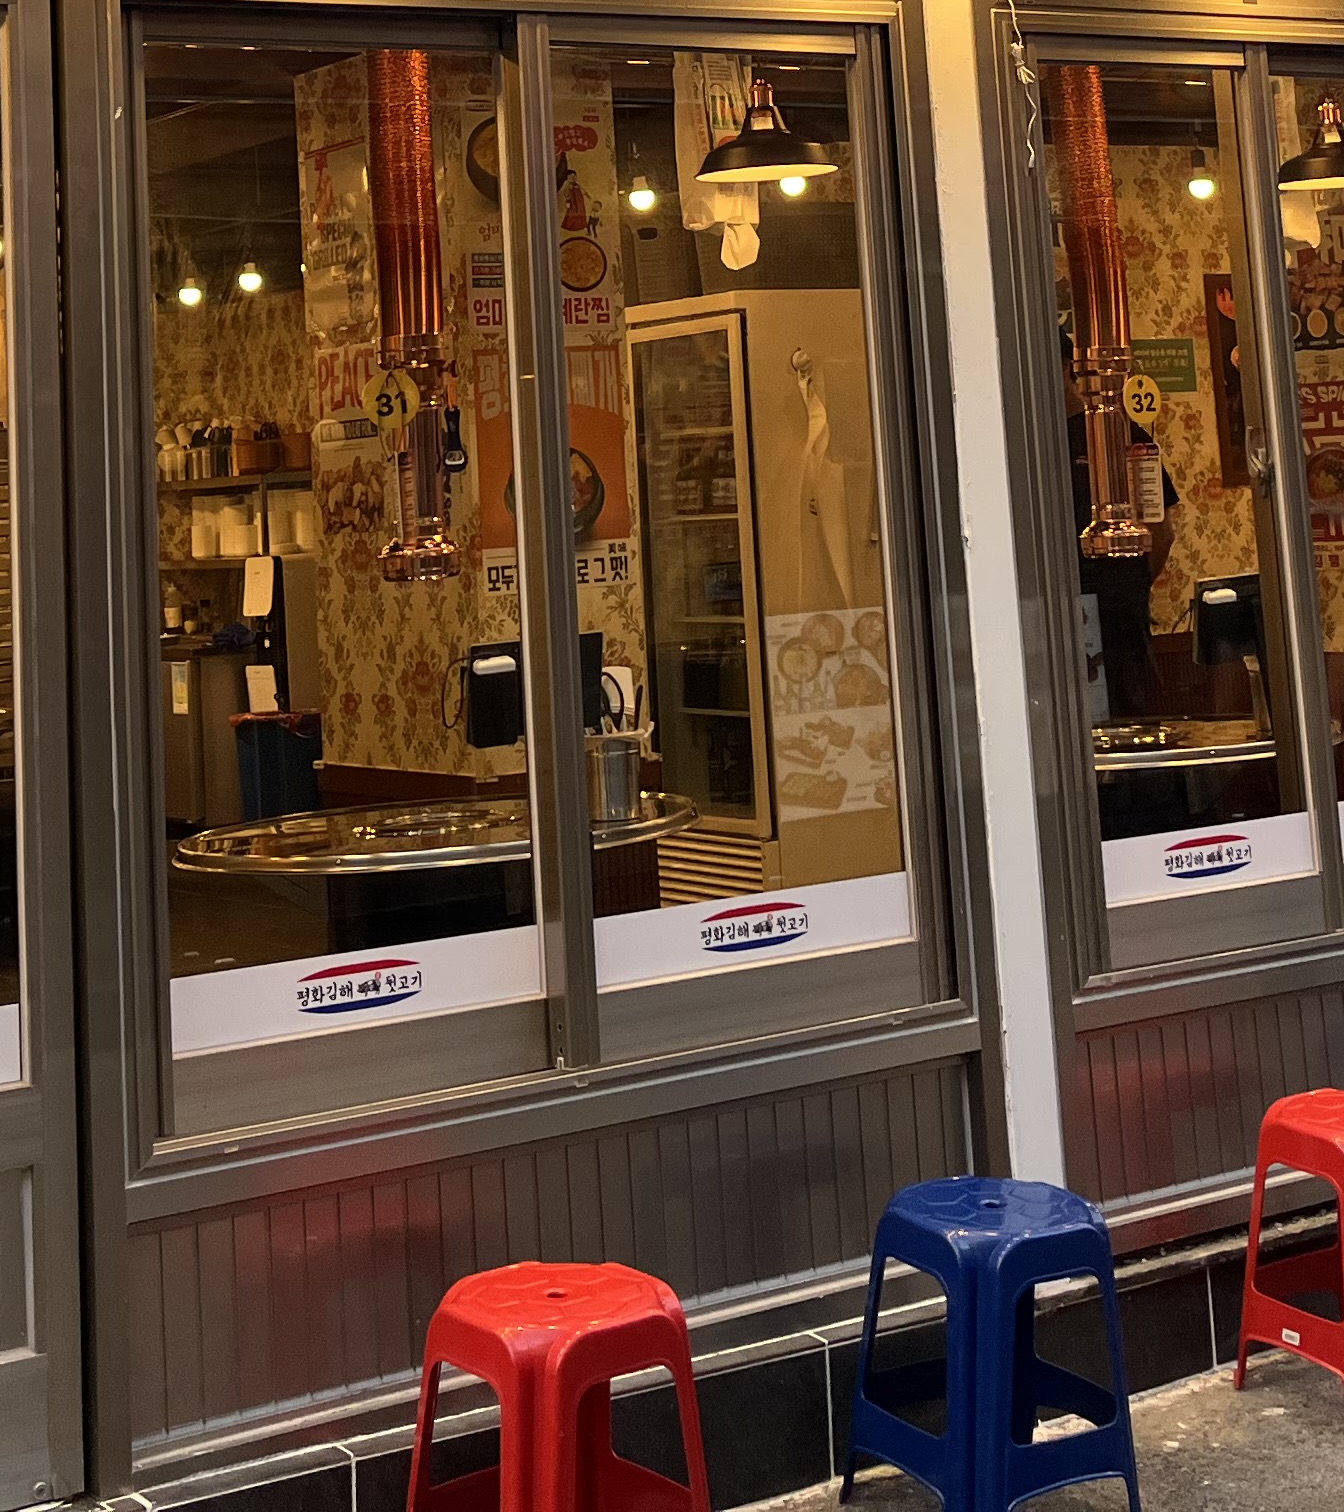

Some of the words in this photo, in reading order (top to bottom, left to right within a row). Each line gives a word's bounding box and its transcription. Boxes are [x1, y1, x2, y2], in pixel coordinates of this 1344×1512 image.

[375, 393, 407, 417] 31
[1131, 392, 1156, 414] 32
[297, 980, 353, 1007] 평화김해
[385, 971, 423, 993] 뒷고기
